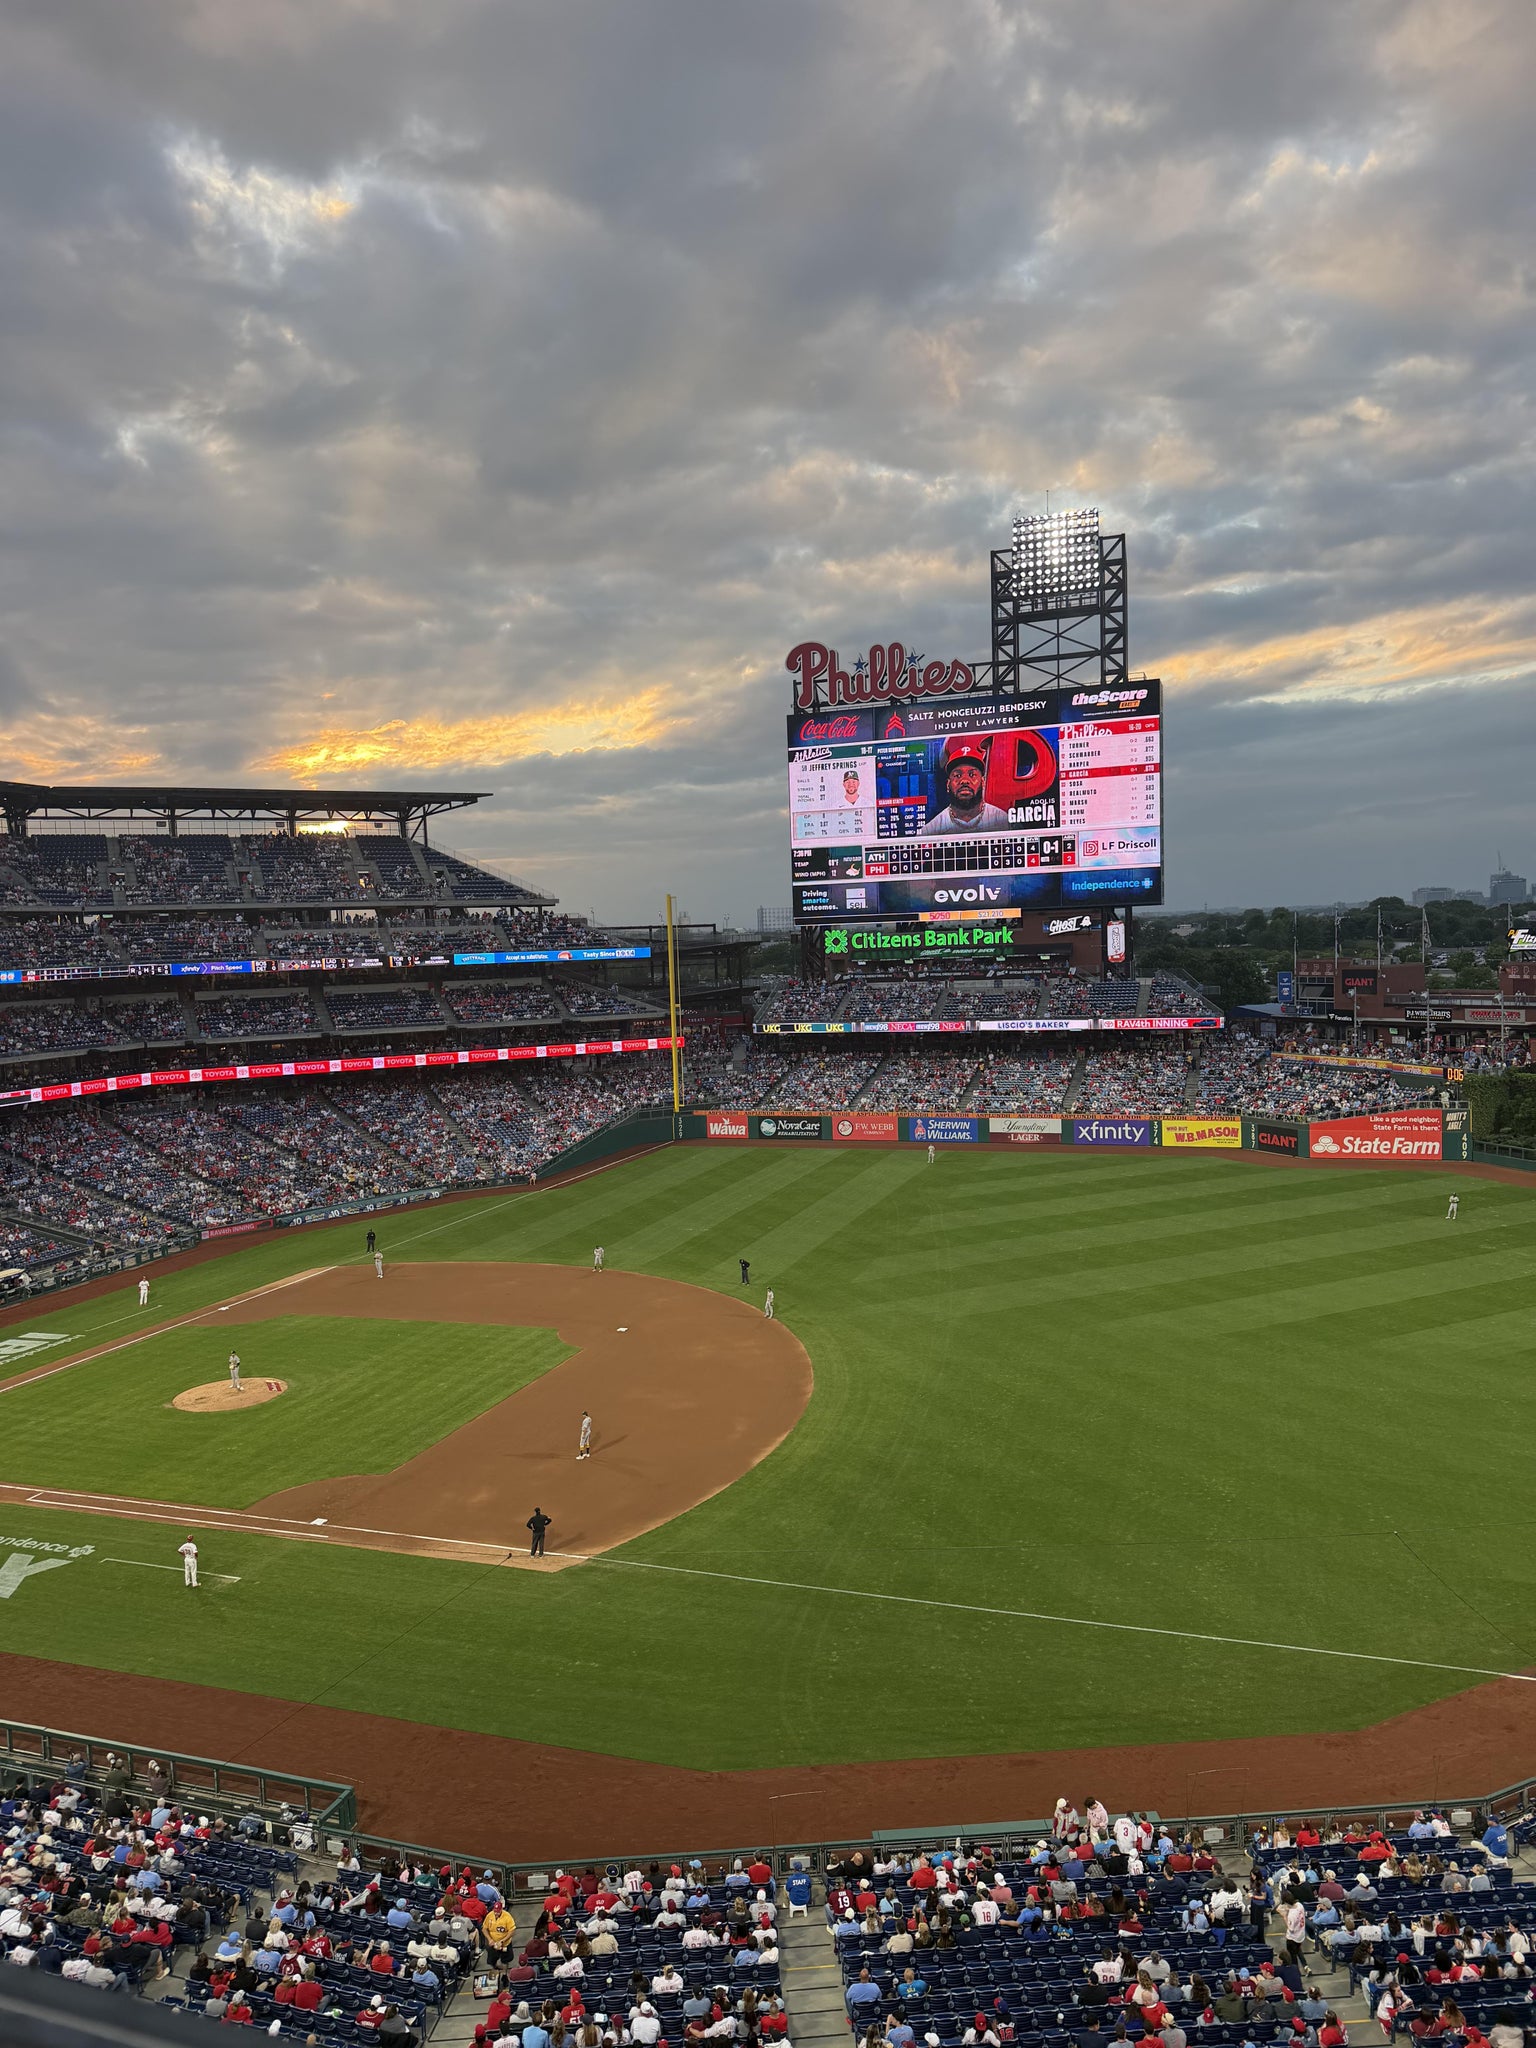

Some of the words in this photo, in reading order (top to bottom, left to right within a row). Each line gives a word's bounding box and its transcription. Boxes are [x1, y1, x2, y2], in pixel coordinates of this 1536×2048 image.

[785, 641, 975, 708] Phillies
[1072, 688, 1148, 706] theScore
[908, 711, 934, 722] SALTZ
[938, 705, 996, 718] MONGELUZZI
[1000, 700, 1047, 712] BENDESKY
[934, 720, 969, 730] INJURY
[976, 716, 1020, 727] LAWYERS
[1060, 724, 1112, 740] Phillies
[792, 747, 832, 762] Athletics
[809, 763, 832, 771] JEFFREY
[833, 761, 857, 770] SPRINGS
[1069, 789, 1097, 797] REALMUTO
[1030, 798, 1055, 806] ADOLIS
[1008, 804, 1056, 824] GARCÍA
[1043, 840, 1059, 854] 0-1
[1102, 842, 1114, 850] LF
[1118, 839, 1157, 850] Driscoll
[868, 853, 885, 862] ATH
[870, 864, 884, 874] PHI
[1072, 880, 1139, 891] Independence
[802, 890, 827, 899] Driving
[934, 884, 1001, 903] evolv
[1050, 916, 1082, 936] GHOST
[851, 932, 921, 949] Citizens
[924, 928, 969, 947] Bank
[973, 926, 1014, 944] Park
[1345, 978, 1374, 986] GIANT
[794, 1024, 812, 1032] UKG
[1117, 1020, 1150, 1028] RAV4th
[44, 1088, 68, 1097] TOYOTA
[83, 1082, 106, 1091] TOYOTA
[118, 1077, 141, 1086] TOYOTA
[154, 1073, 185, 1081] TOYOTA
[205, 1070, 234, 1078] TOYOTA
[510, 1049, 535, 1057] TOYOTA
[588, 1044, 611, 1052] TOYOTA
[1447, 1068, 1464, 1081] 0:06
[709, 1123, 746, 1135] Wawa
[777, 1120, 820, 1130] NovaCare
[928, 1120, 970, 1129] SHERWIN
[1002, 1120, 1048, 1132] Yuengling
[1447, 1122, 1462, 1130] ANGLE
[1078, 1121, 1144, 1142] xfinity
[1175, 1127, 1239, 1143] W.B.MASON
[1259, 1134, 1297, 1148] GIANT
[331, 1210, 340, 1218] 10
[210, 1228, 231, 1237] RAV4th
[232, 1222, 254, 1233] INNING
[1123, 1827, 1128, 1836] 3
[630, 1880, 638, 1891] 11
[838, 1896, 850, 1908] 19
[982, 1912, 992, 1922] 16
[316, 1948, 322, 1958] 3
[1000, 2025, 1015, 2040] 12
